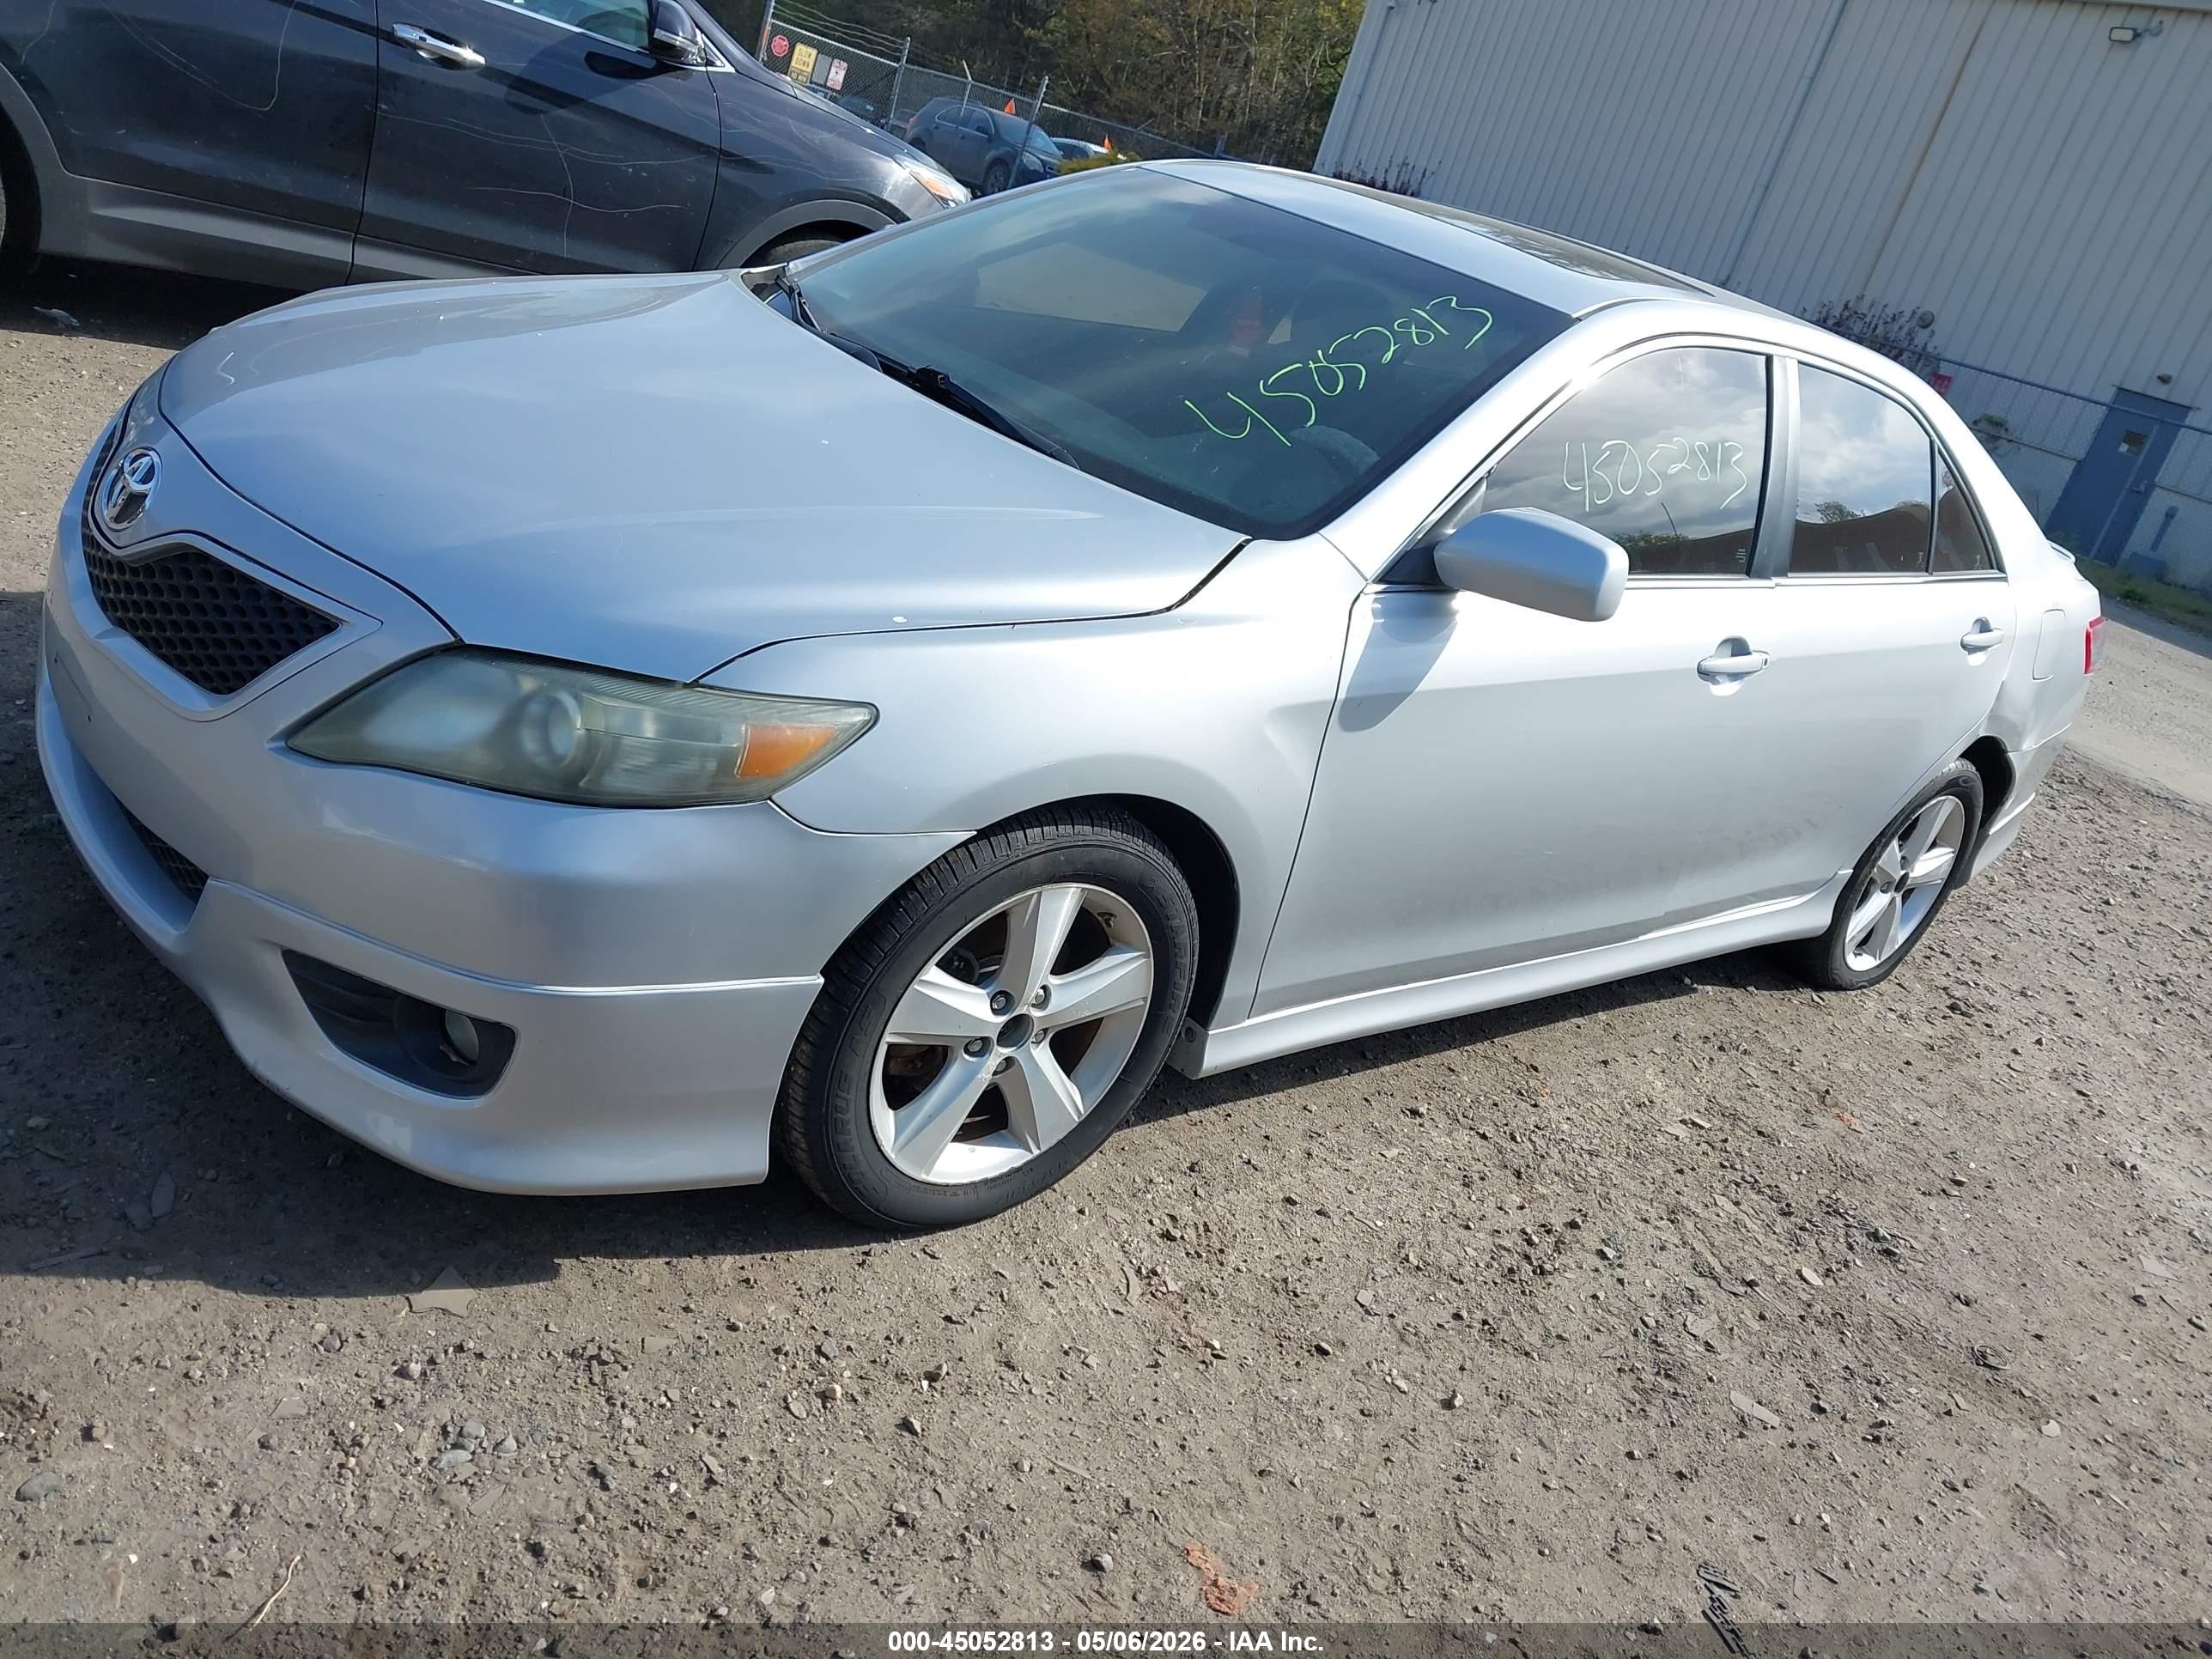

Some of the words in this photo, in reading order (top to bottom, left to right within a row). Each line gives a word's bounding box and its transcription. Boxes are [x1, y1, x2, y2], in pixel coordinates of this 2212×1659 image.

[794, 57, 810, 69] DOWN
[798, 46, 812, 58] SLOW
[1184, 295, 1493, 447] 45052813
[1563, 437, 1747, 513] 45052813
